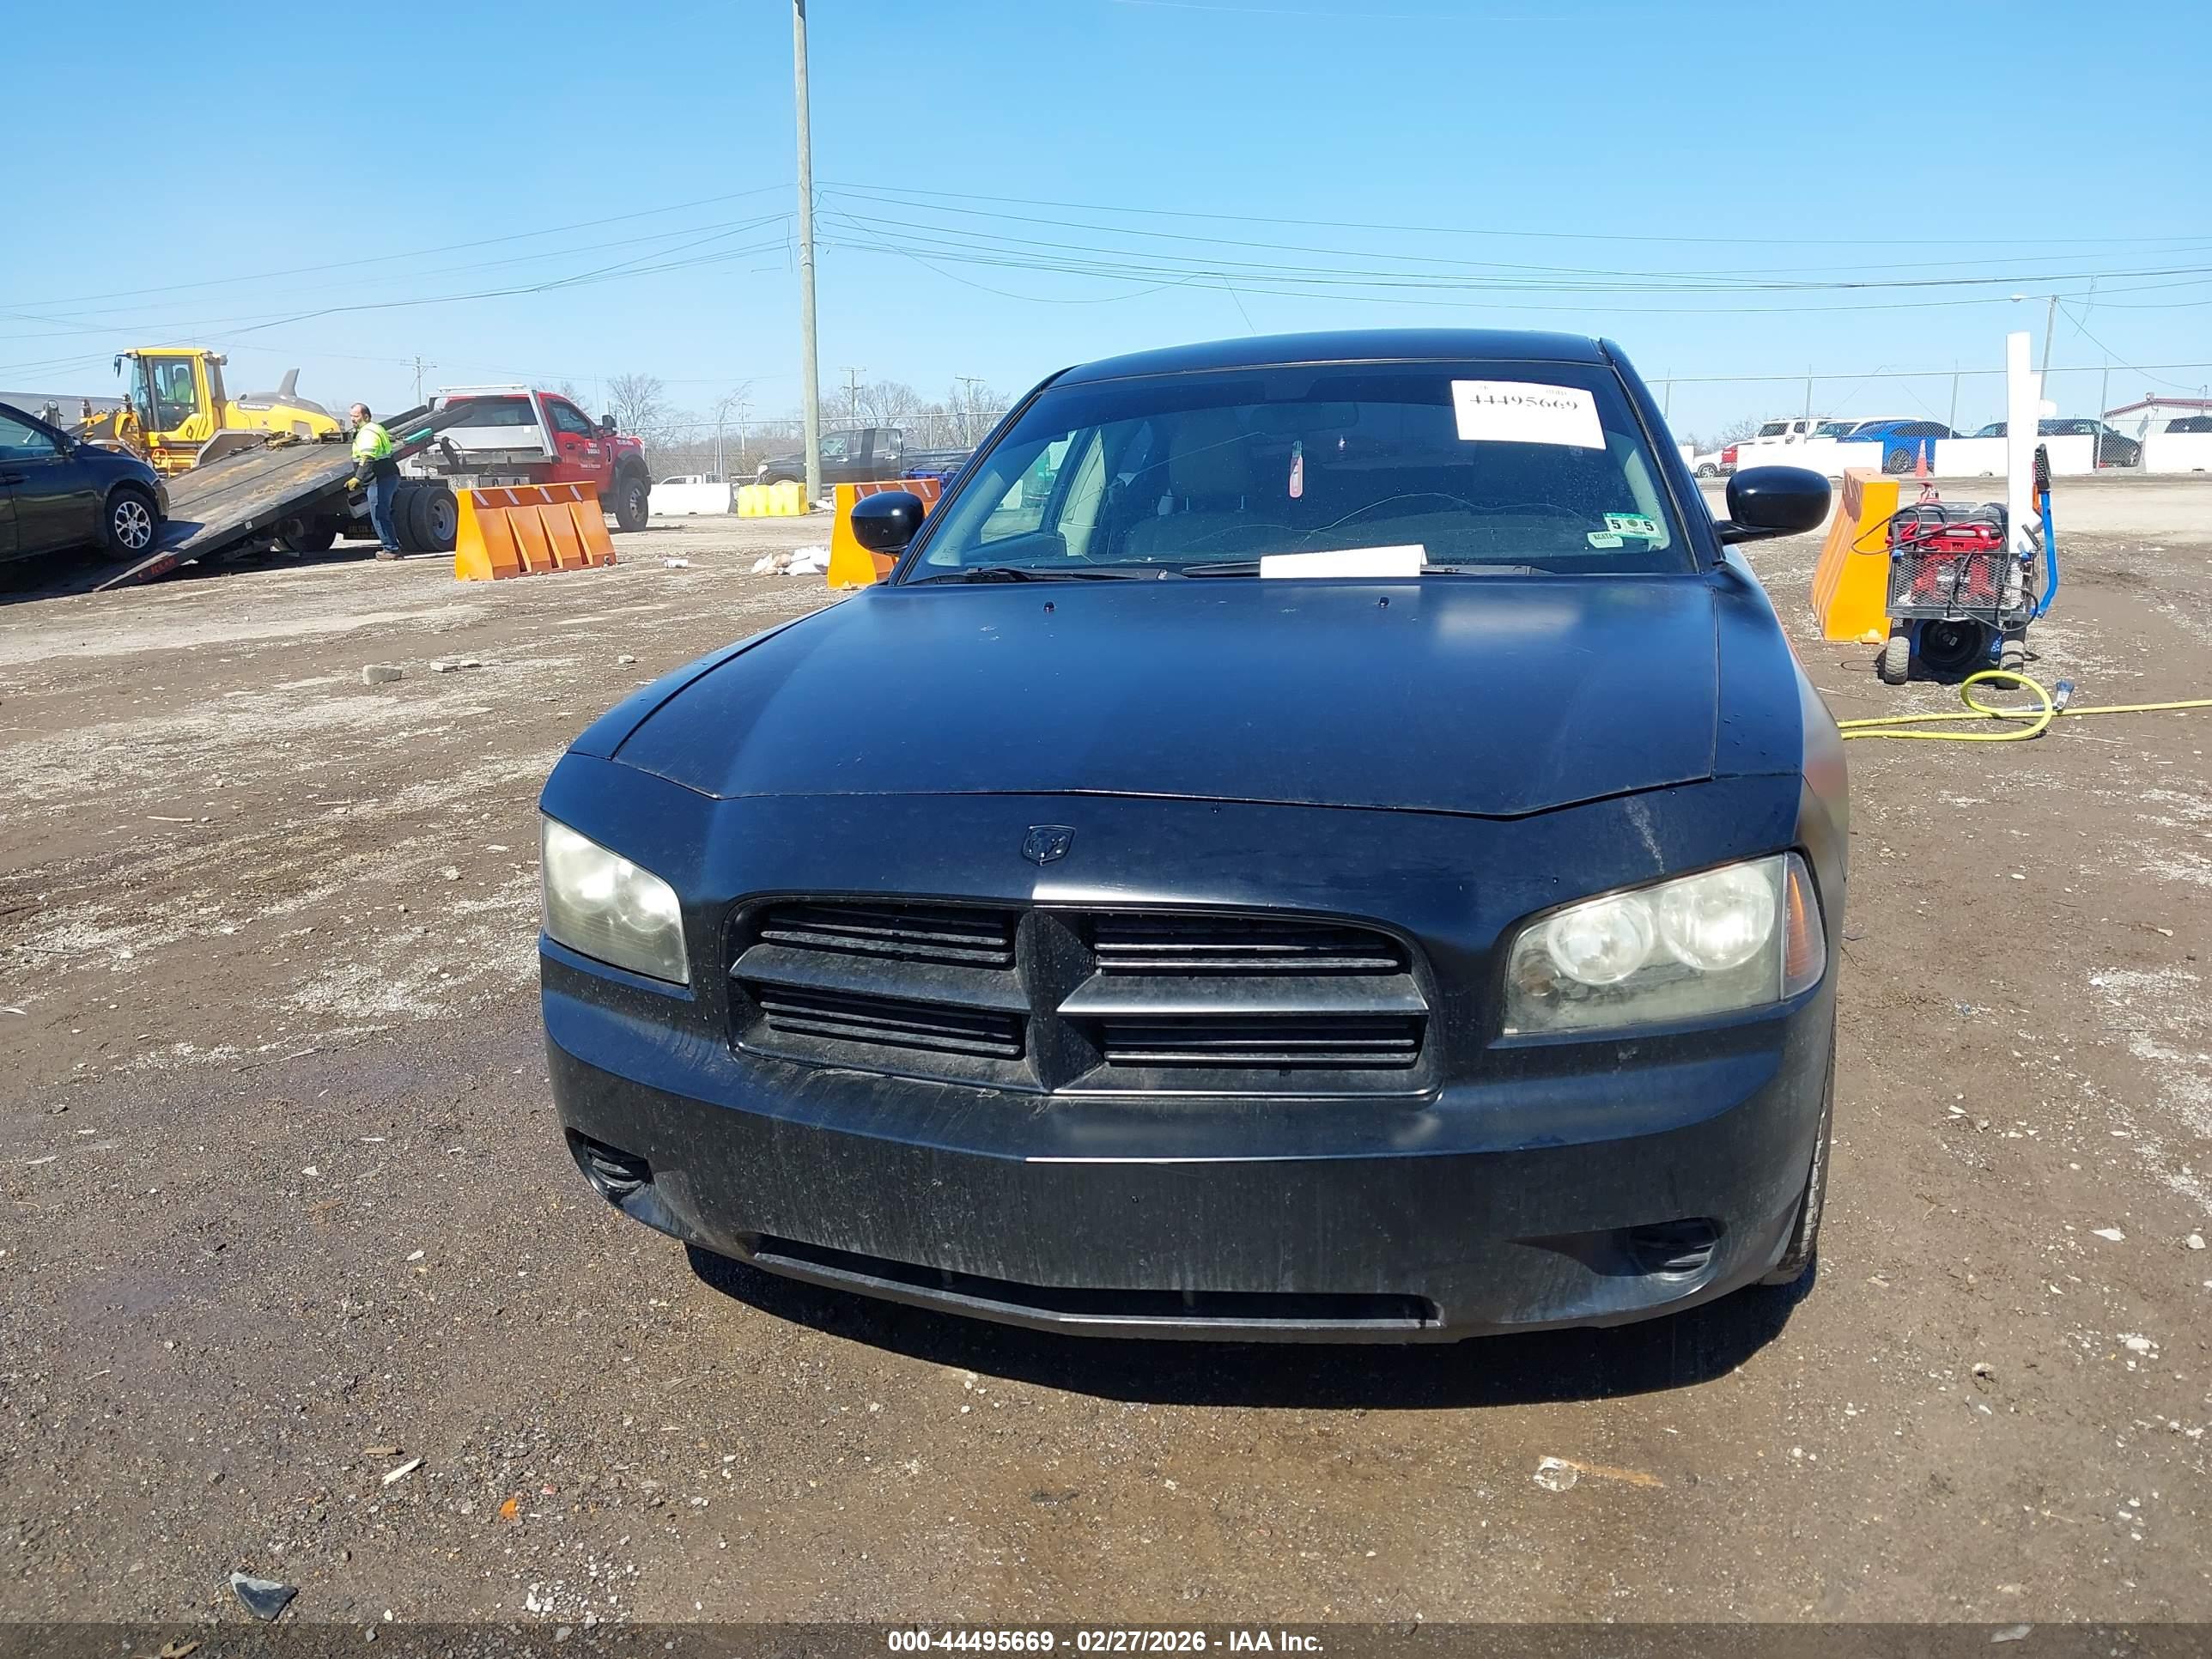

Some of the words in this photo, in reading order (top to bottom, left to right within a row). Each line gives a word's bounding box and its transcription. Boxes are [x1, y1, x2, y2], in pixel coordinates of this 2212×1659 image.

[1469, 394, 1578, 410] 44495669
[1610, 519, 1622, 530] 5
[1644, 520, 1655, 532] 5
